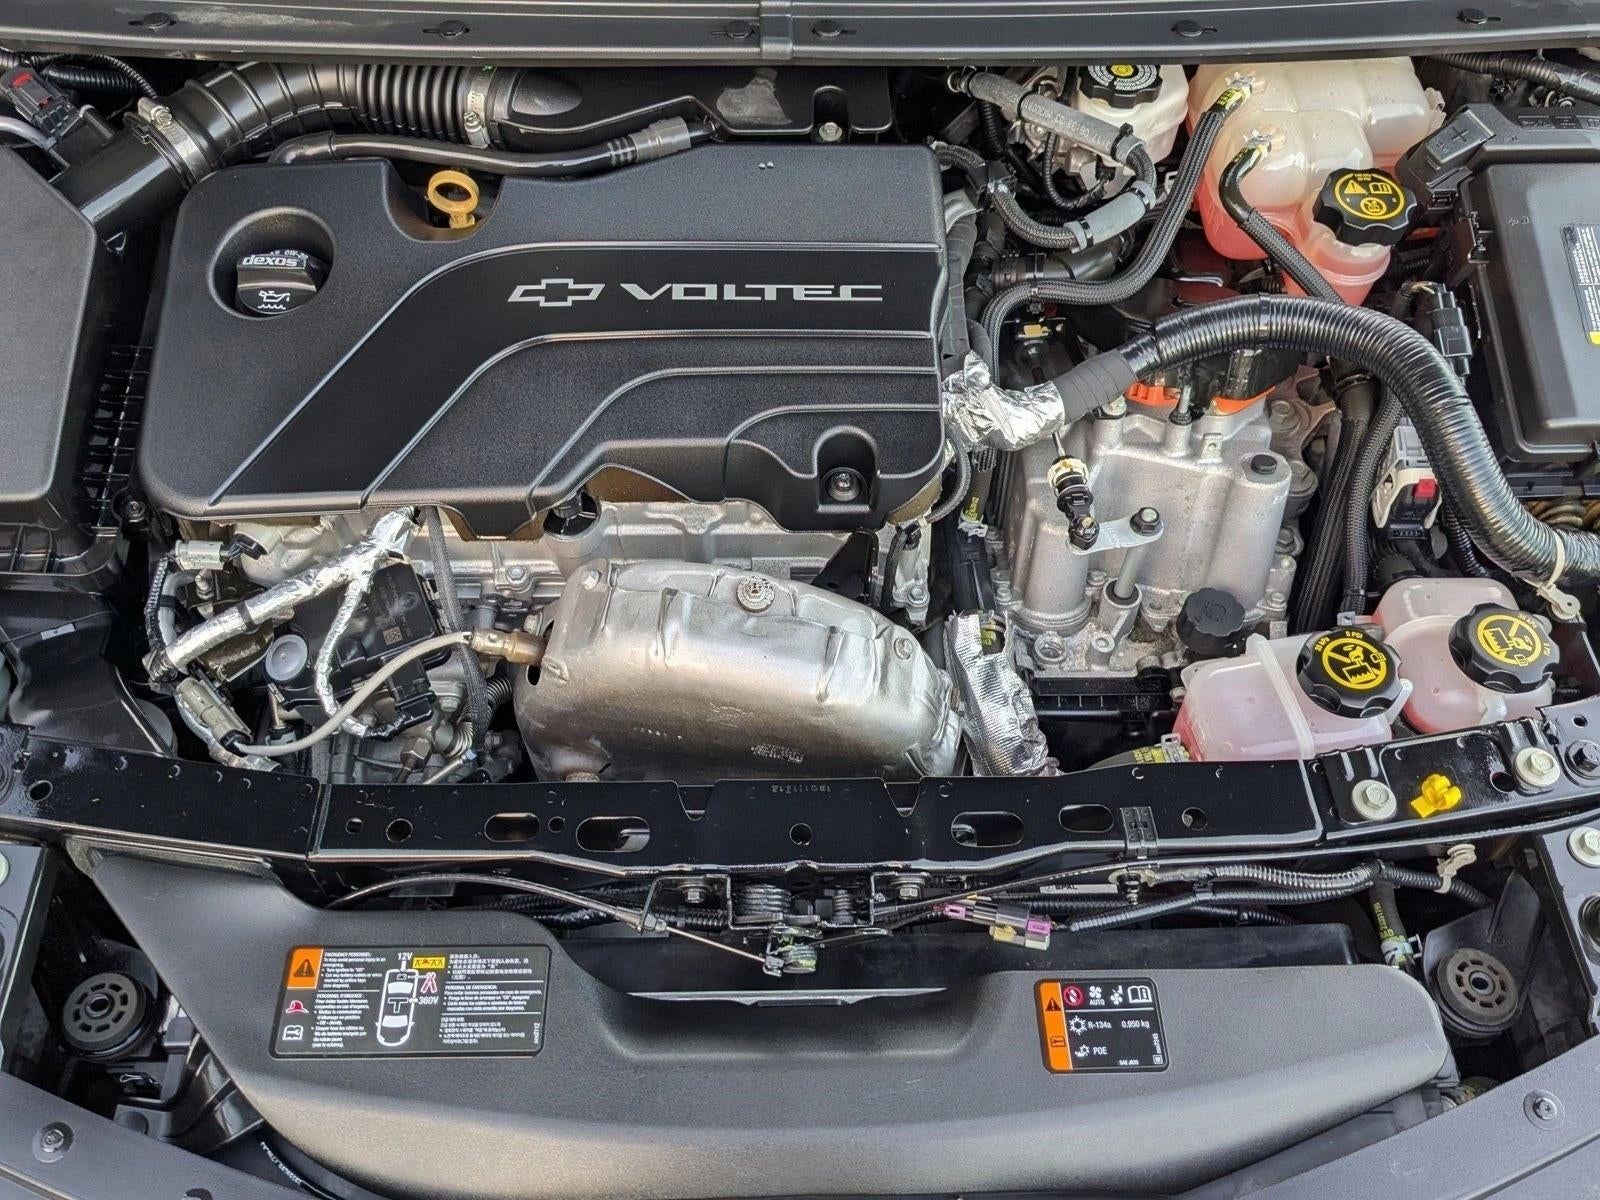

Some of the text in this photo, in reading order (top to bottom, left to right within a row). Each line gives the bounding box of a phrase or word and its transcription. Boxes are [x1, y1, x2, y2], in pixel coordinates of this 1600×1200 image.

[242, 254, 298, 267] dexos
[620, 283, 883, 301] VOLTEC
[397, 952, 413, 961] 12V
[419, 996, 439, 1005] 360V
[1088, 1020, 1112, 1029] R-134a
[1121, 1020, 1150, 1029] 0.950 kg
[1093, 1046, 1108, 1055] POE
